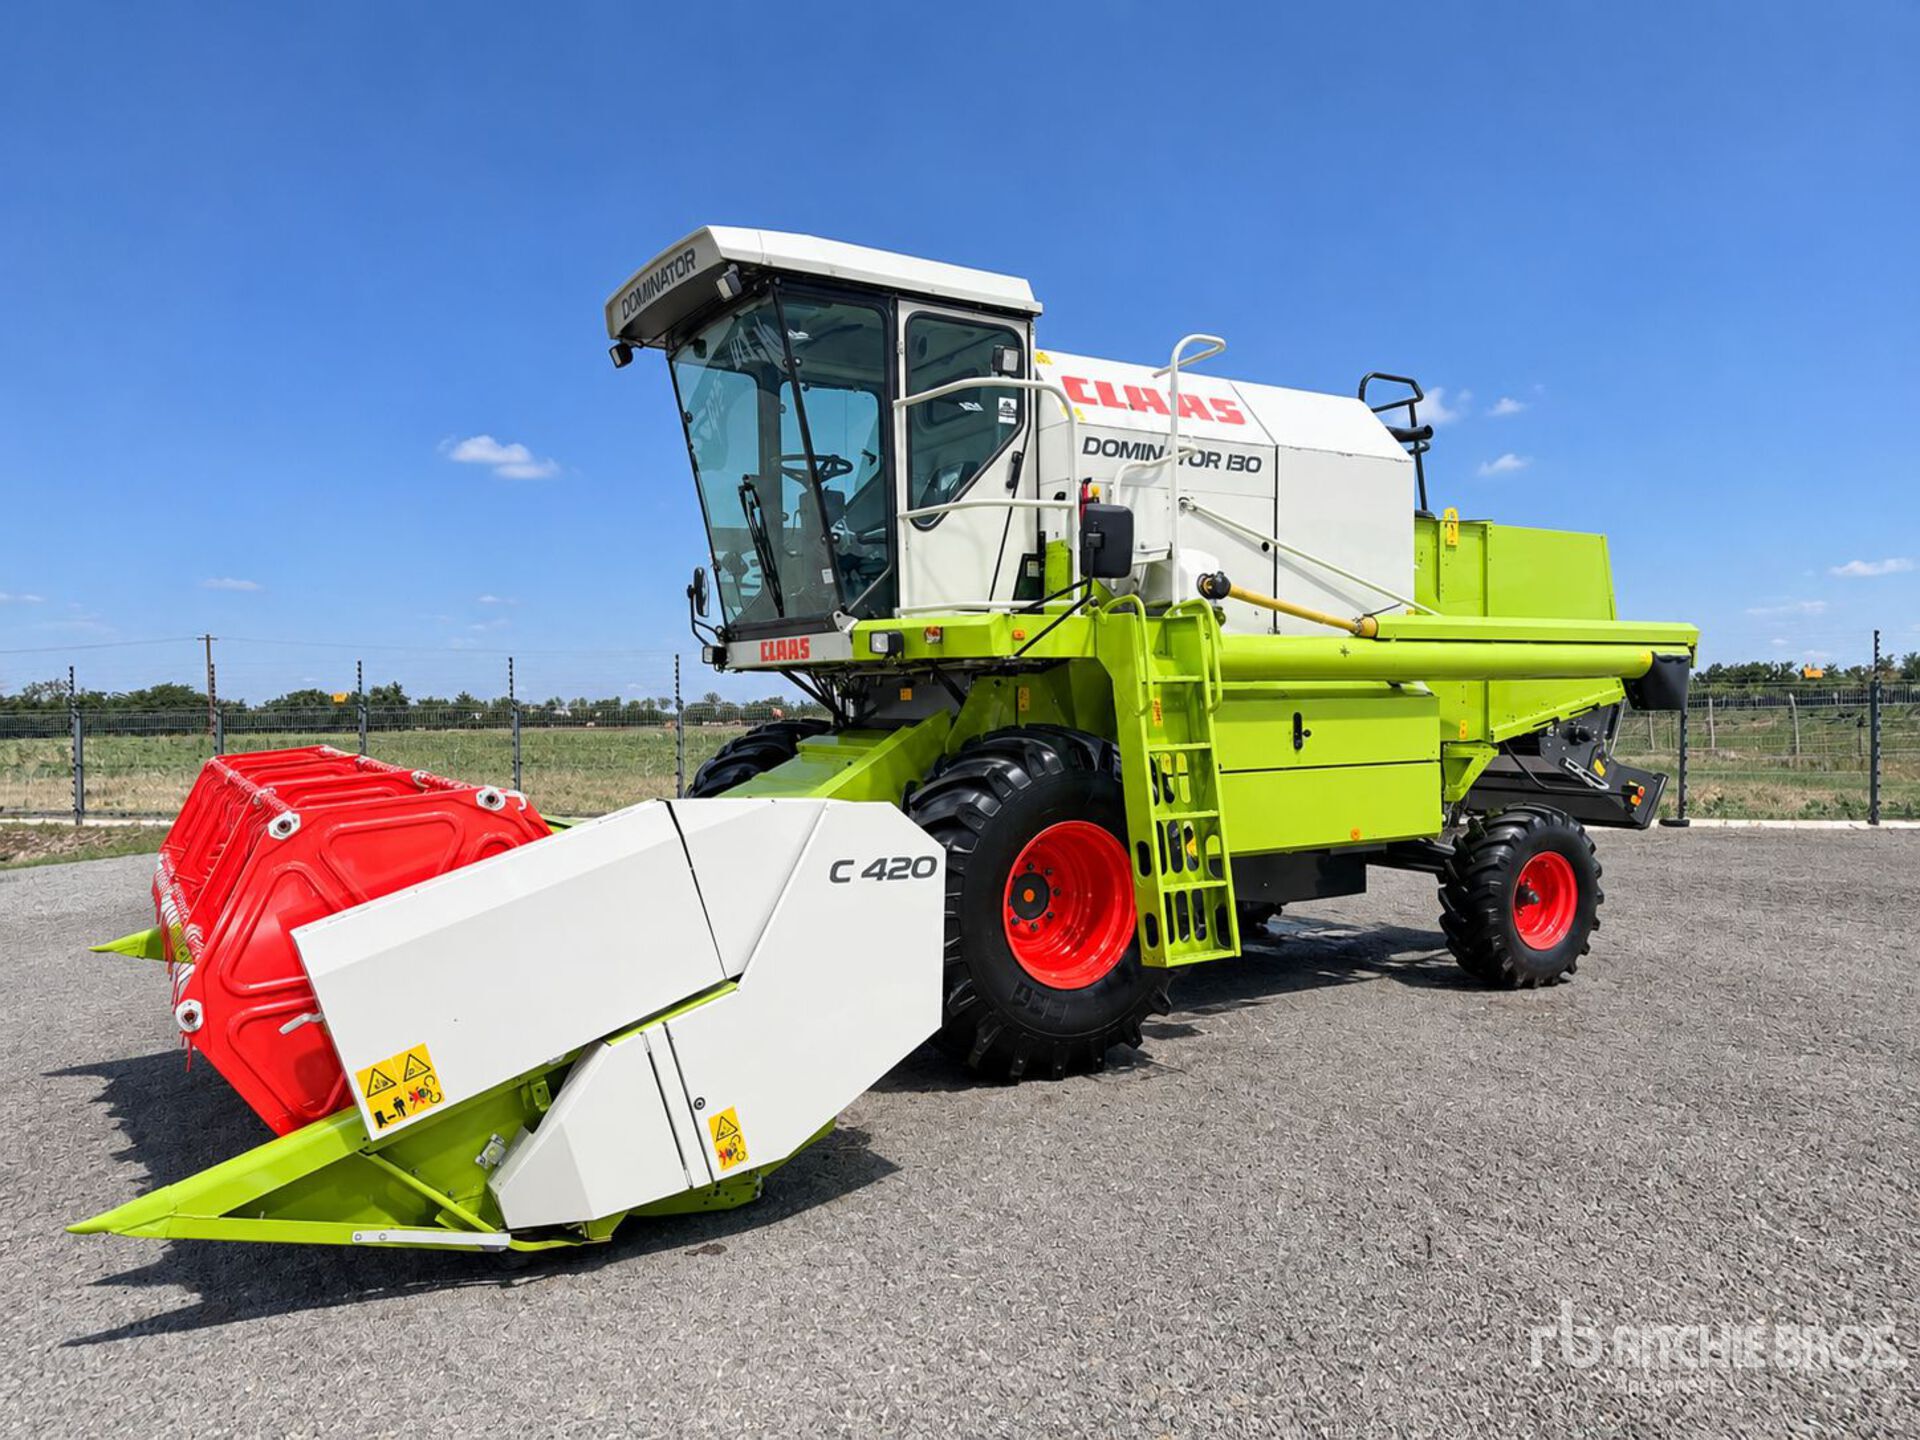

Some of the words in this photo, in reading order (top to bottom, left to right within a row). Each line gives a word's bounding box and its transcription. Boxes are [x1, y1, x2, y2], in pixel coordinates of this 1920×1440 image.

[622, 247, 696, 320] DOMINATOR
[1061, 376, 1246, 425] CLAAS
[1082, 437, 1222, 470] DOMINTOR
[1226, 454, 1263, 474] 130
[759, 637, 810, 662] CLAAS
[829, 860, 855, 884] C
[861, 855, 938, 881] 420
